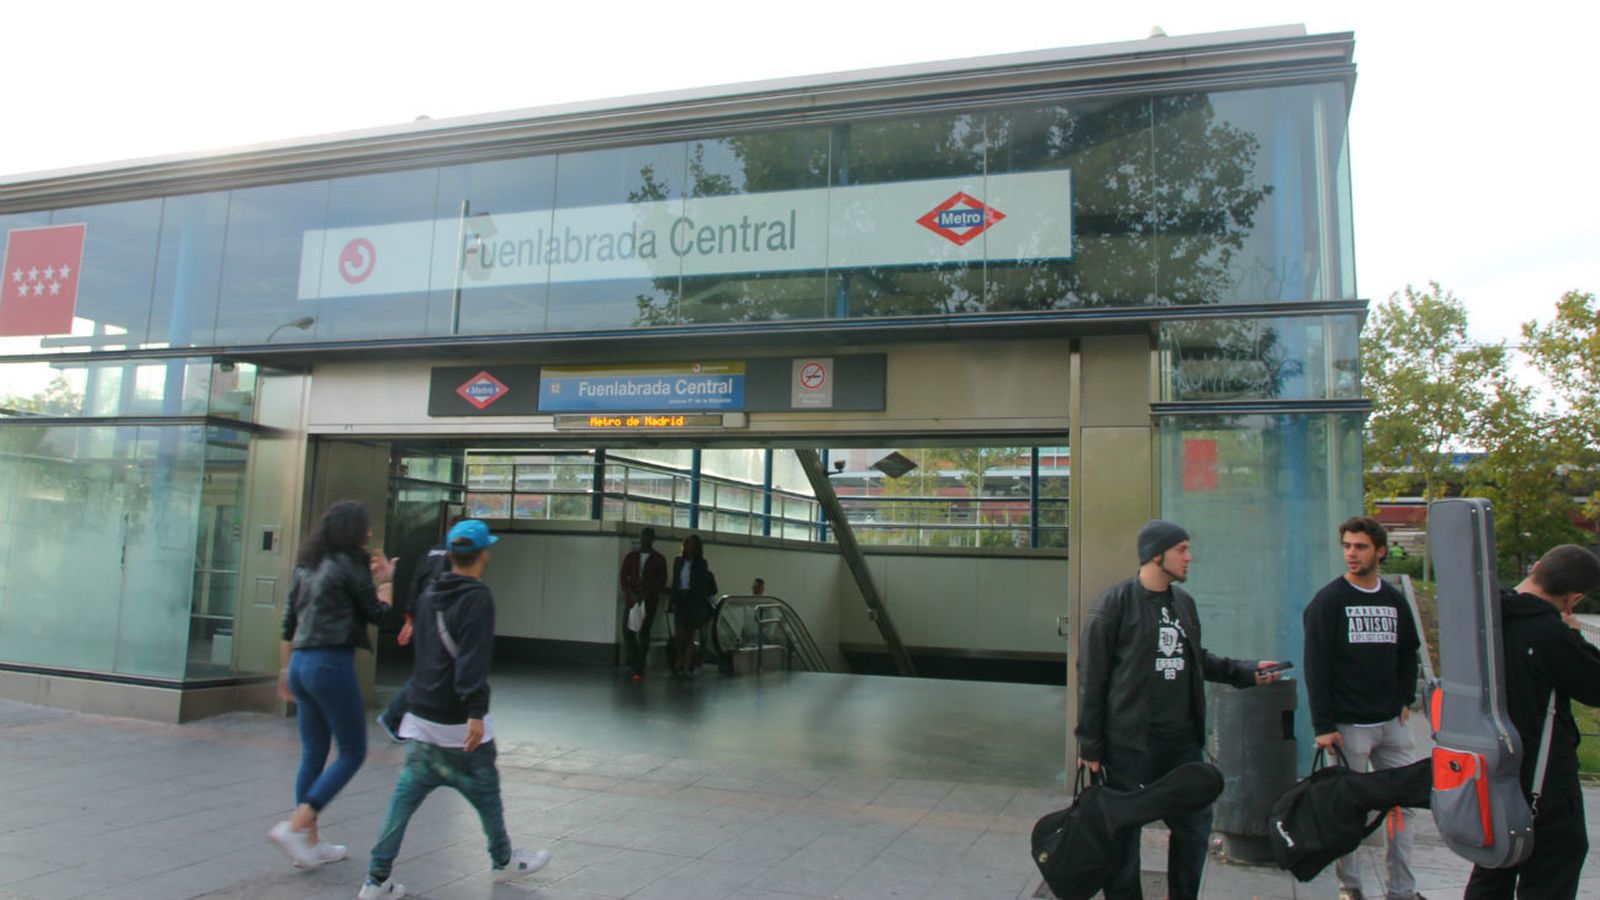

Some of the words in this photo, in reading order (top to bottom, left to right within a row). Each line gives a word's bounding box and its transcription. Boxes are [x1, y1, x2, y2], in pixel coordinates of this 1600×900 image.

[941, 212, 981, 225] Metro
[462, 221, 657, 270] Fuenlabrada
[670, 209, 797, 257] Central
[470, 385, 494, 395] Metro
[578, 379, 671, 397] Fuenlabrada
[675, 378, 733, 395] Central
[590, 416, 622, 427] Metro
[626, 416, 640, 427] de
[644, 415, 685, 427] Madrid
